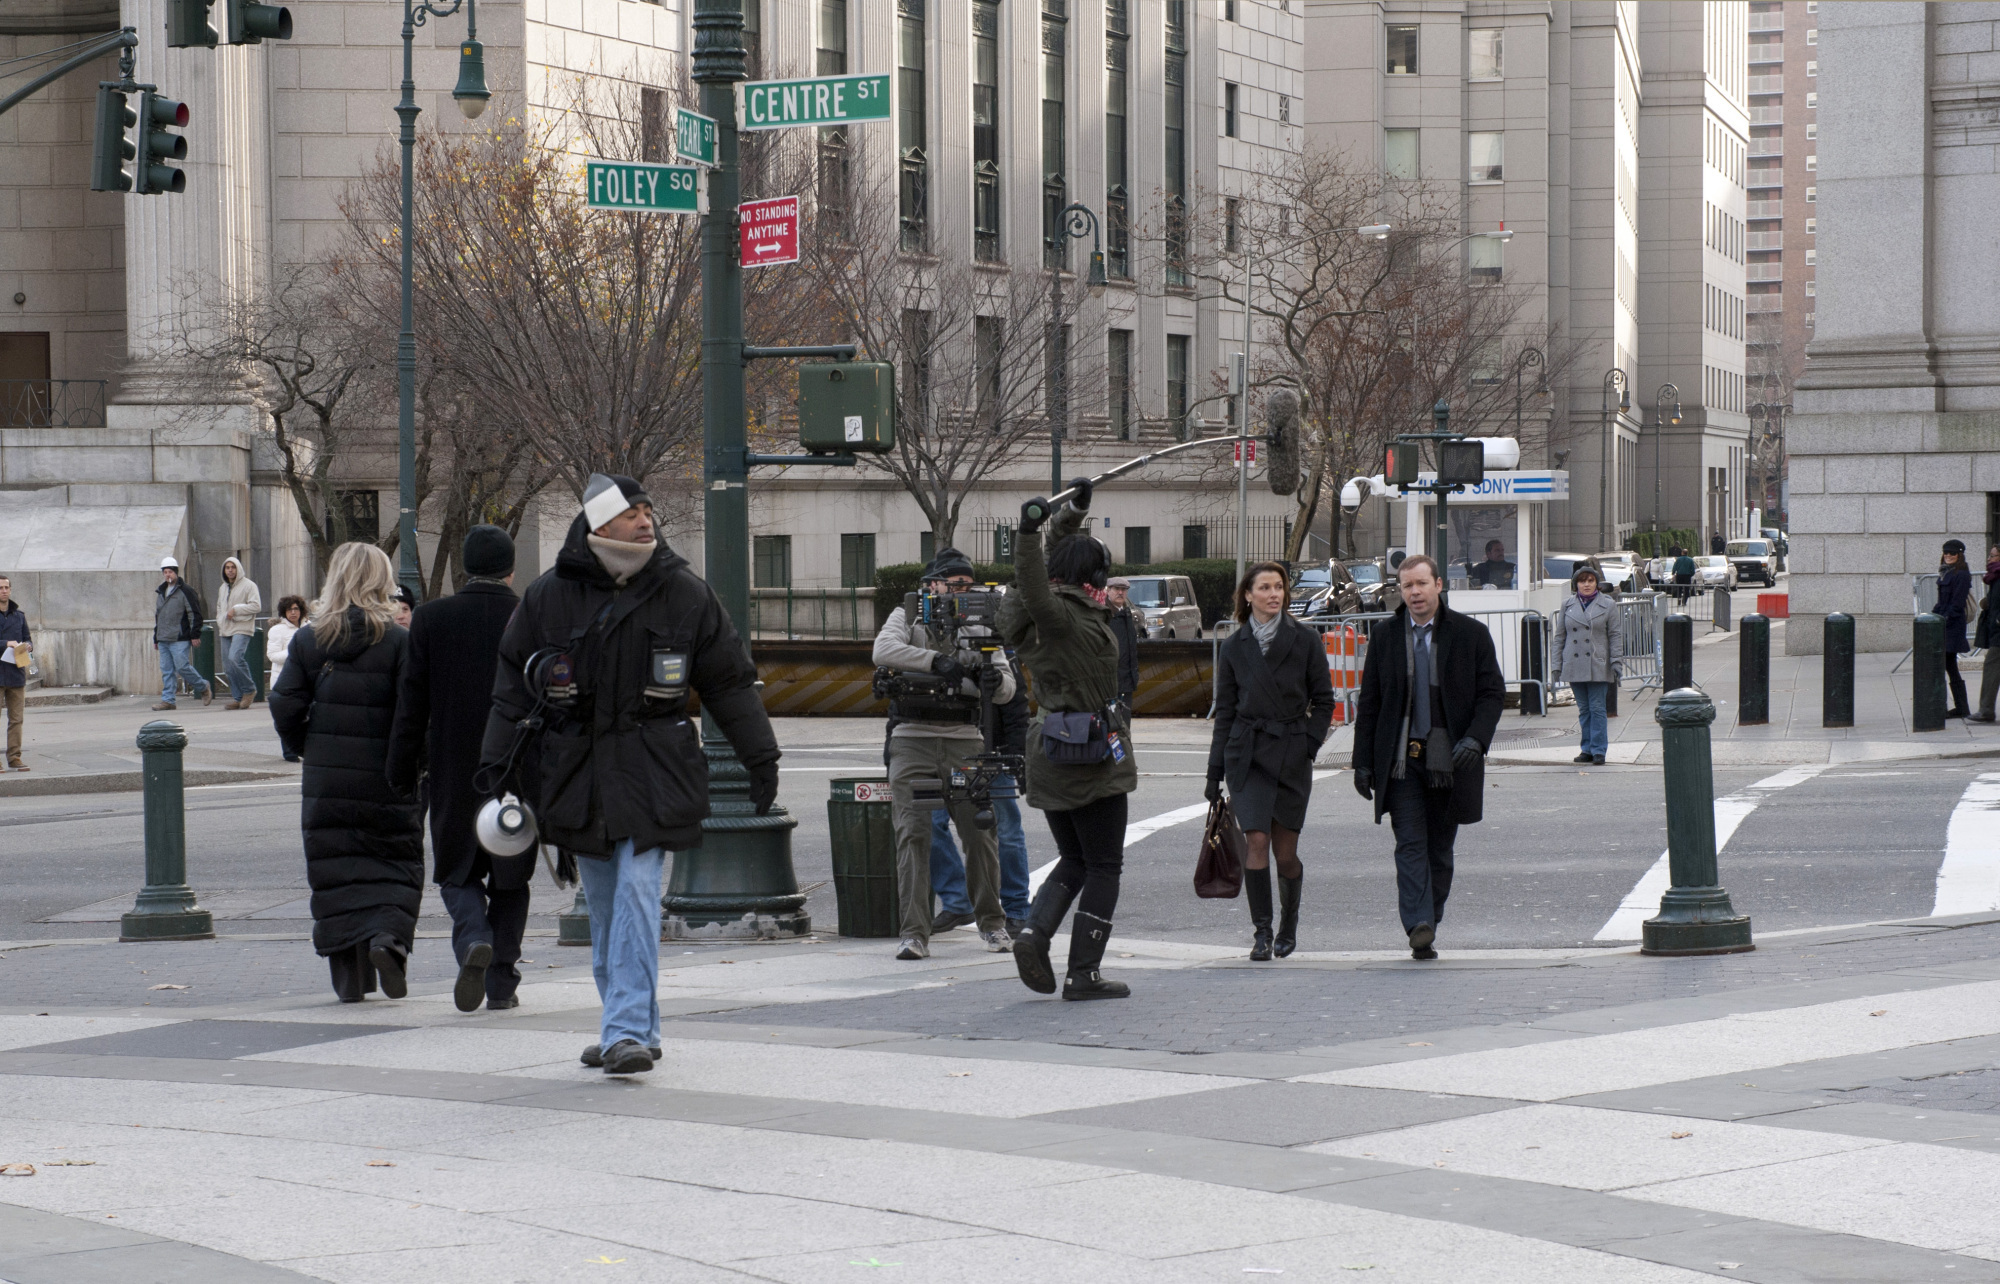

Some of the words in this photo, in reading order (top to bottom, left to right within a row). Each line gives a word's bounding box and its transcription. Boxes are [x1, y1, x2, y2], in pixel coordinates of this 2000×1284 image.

[751, 82, 847, 123] CENTRE
[857, 80, 881, 99] ST
[679, 114, 702, 156] PEARL
[704, 123, 713, 143] ST
[594, 167, 659, 206] FOLEY
[670, 172, 693, 191] SQ
[741, 210, 751, 223] NO
[756, 204, 795, 221] STANDING
[748, 223, 789, 240] ANYTIME
[1472, 478, 1511, 494] SDNY
